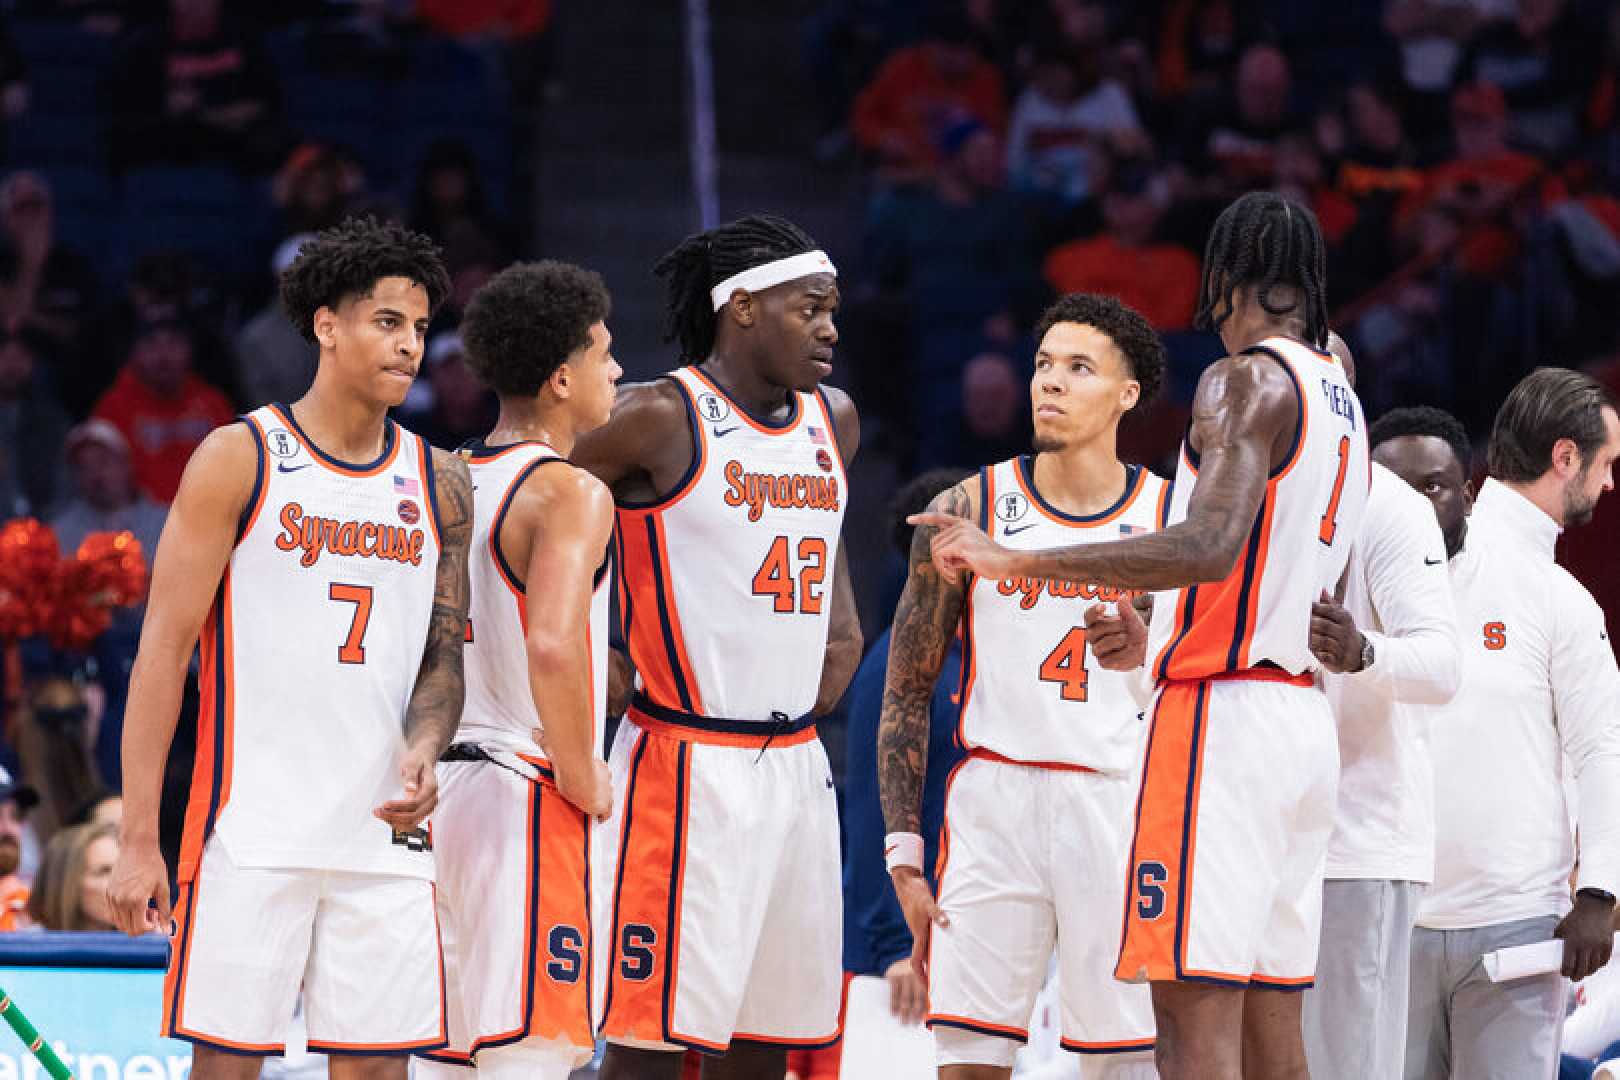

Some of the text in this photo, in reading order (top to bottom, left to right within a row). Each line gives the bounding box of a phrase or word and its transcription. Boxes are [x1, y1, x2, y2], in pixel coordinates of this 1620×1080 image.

[723, 459, 839, 522] Syracuse
[1319, 433, 1350, 547] 1
[275, 502, 425, 568] Syracuse
[751, 535, 827, 614] 42
[997, 576, 1143, 610] yrac
[328, 581, 374, 664] 7
[1483, 621, 1506, 651] S
[1038, 625, 1089, 702] 4
[1136, 860, 1168, 920] S
[546, 923, 584, 984] S
[621, 922, 656, 982] S
